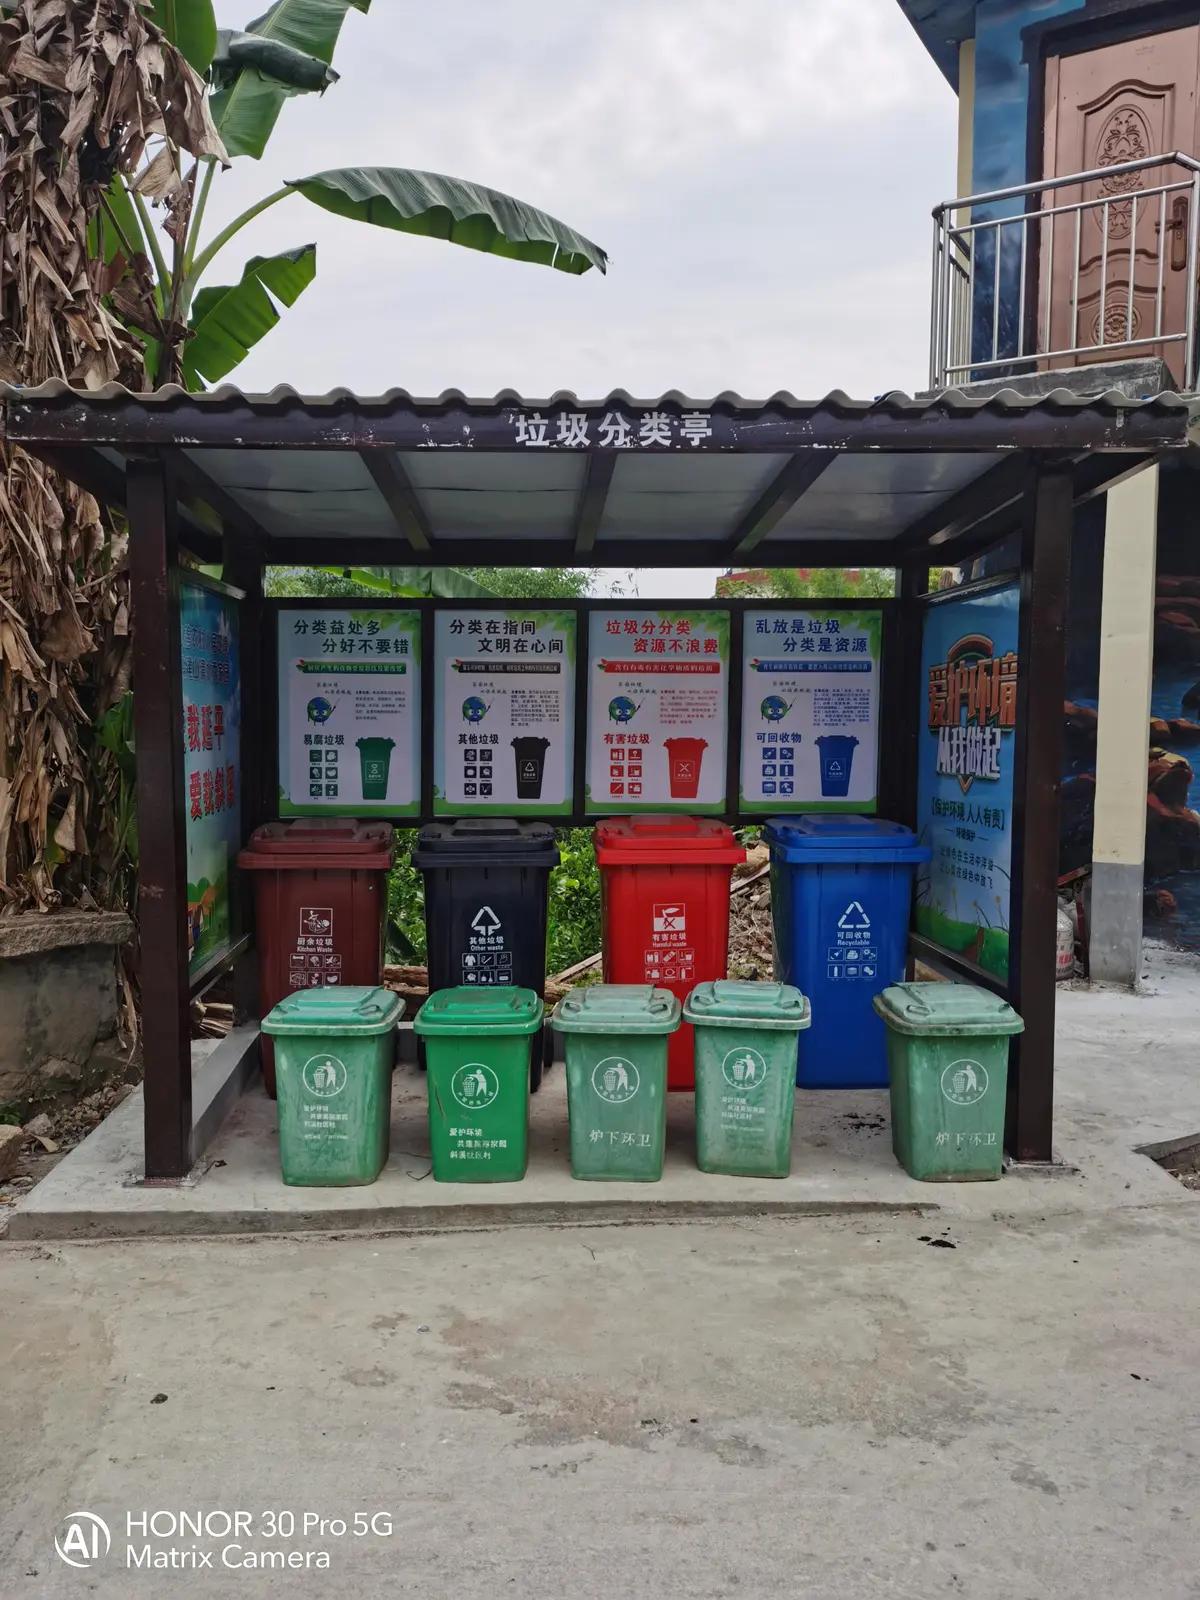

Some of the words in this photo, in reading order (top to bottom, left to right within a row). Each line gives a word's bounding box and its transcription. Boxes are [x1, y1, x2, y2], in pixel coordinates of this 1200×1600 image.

[515, 411, 712, 447] 垃圾分类亭
[293, 619, 381, 636] 分类益处多
[449, 619, 536, 635] 分类在指间
[606, 619, 691, 635] 垃圾分分类
[755, 618, 841, 634] 乱放是垃圾
[322, 638, 410, 654] 分好不要错
[477, 638, 564, 654] 文明在心间
[633, 638, 718, 654] 资源不浪费
[783, 637, 868, 652] 分类是资源
[928, 653, 1018, 729] 爱护环境
[303, 733, 345, 746] 易腐垃圾
[458, 733, 499, 745] 其他垃圾
[603, 733, 651, 745] 有害垃圾
[756, 732, 802, 744] 可回收物
[936, 726, 1001, 778] 从我做起
[297, 937, 333, 946] 厨余垃圾
[469, 936, 504, 945] 其他垃圾
[652, 932, 687, 942] 有害垃圾
[837, 931, 871, 939] 可回收物
[449, 1127, 482, 1137] 爱护环境
[589, 1129, 651, 1147] 炉下环卫
[935, 1131, 997, 1146] 炉下环卫
